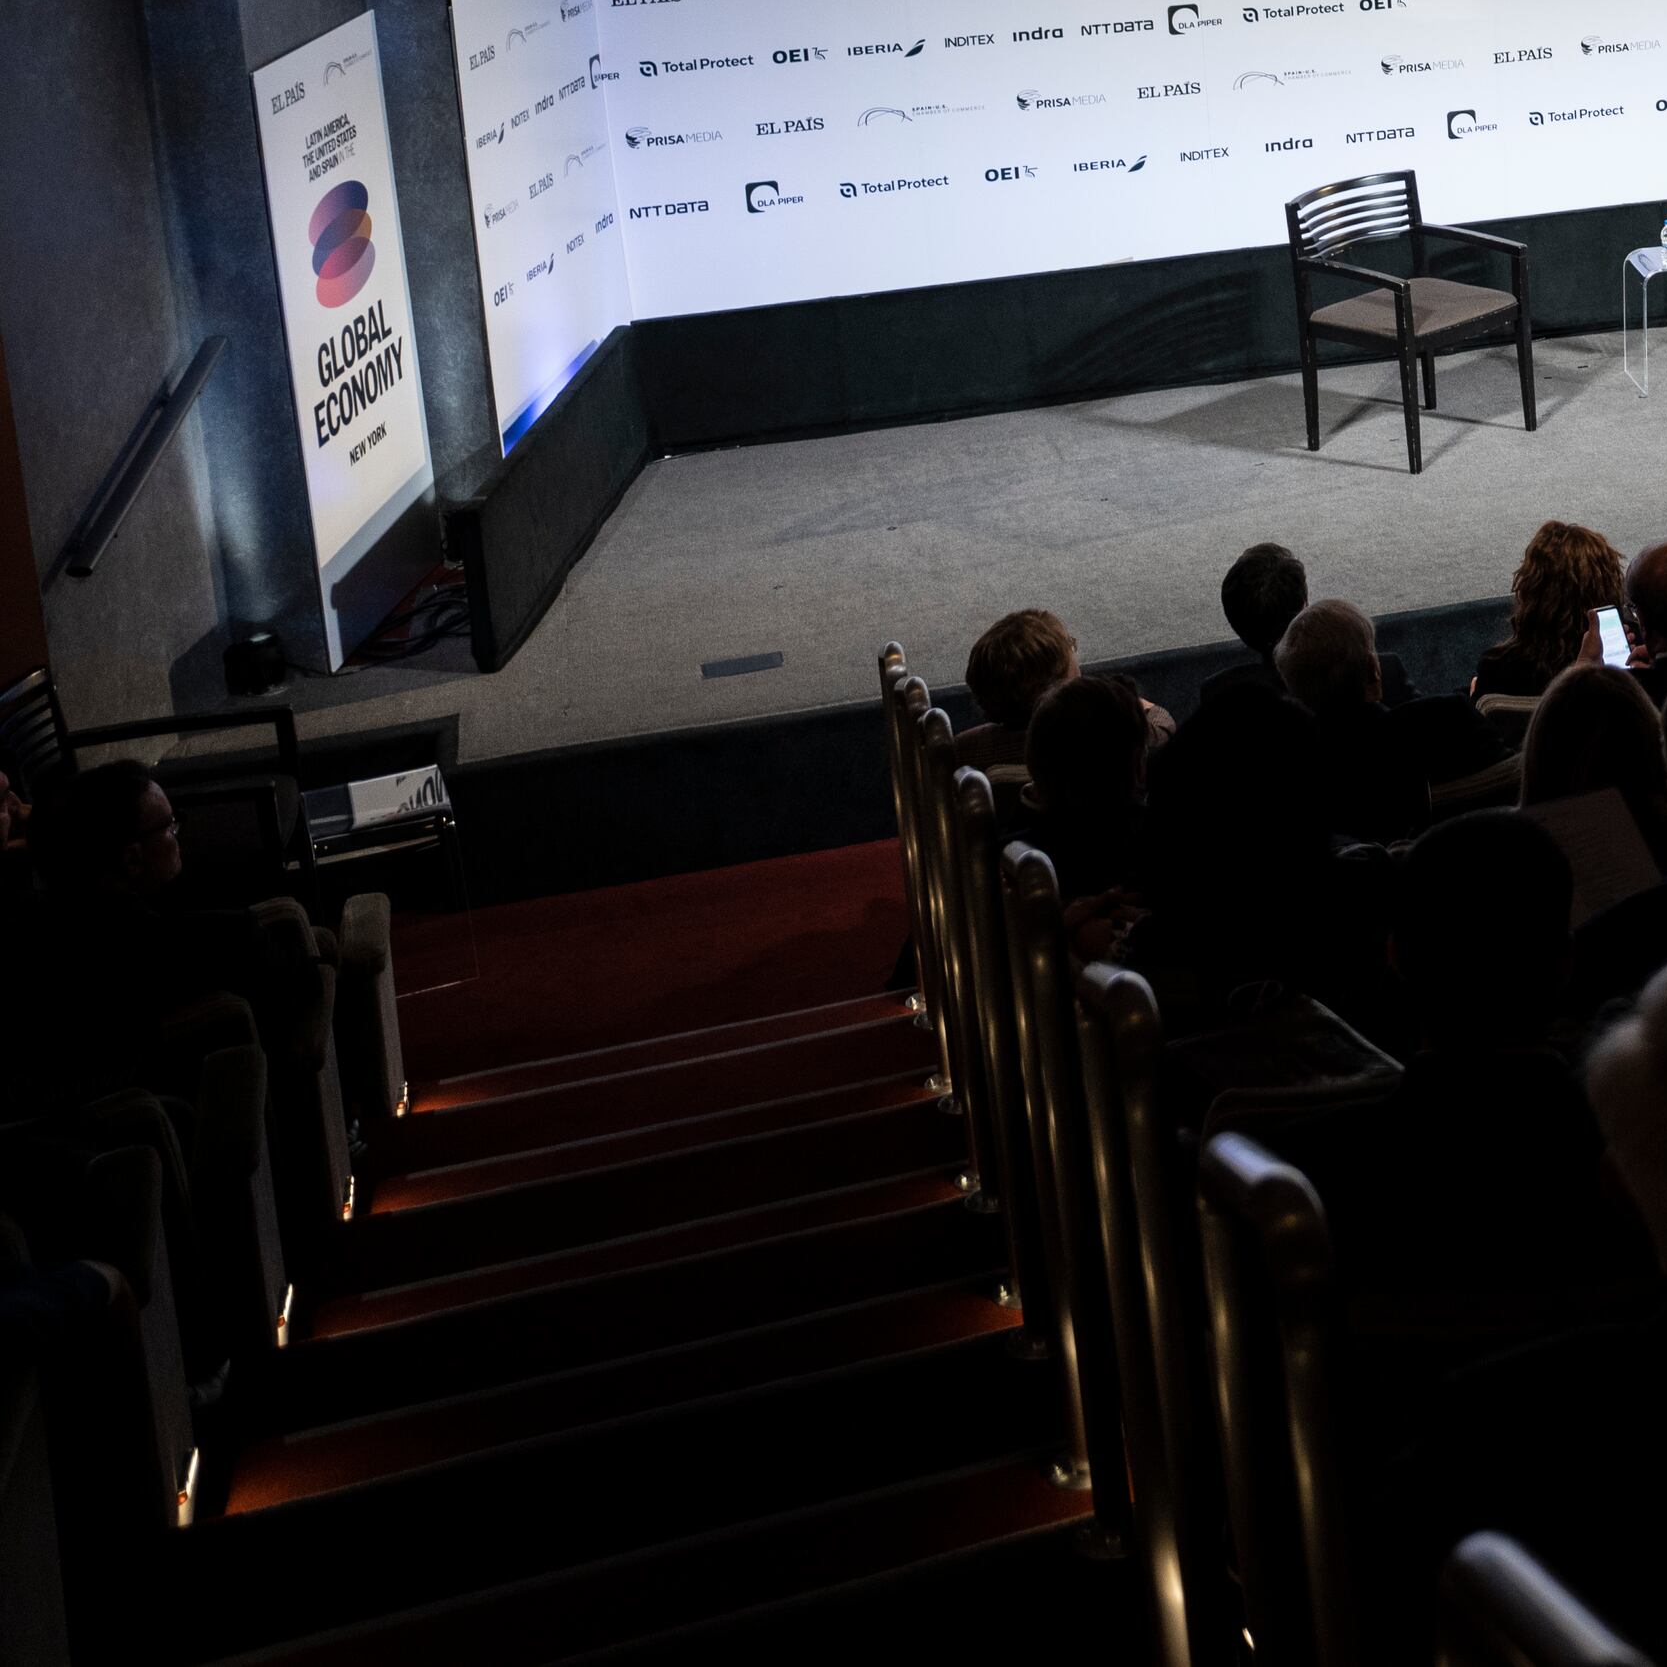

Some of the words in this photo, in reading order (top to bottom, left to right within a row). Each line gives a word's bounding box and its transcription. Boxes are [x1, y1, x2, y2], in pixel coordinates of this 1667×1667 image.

[1263, 6, 1294, 19] Total
[1297, 1, 1344, 16] Protect
[1198, 18, 1222, 27] PIPER
[847, 43, 903, 57] IBERIA
[945, 34, 995, 48] INDITEX
[662, 60, 697, 73] Total
[700, 54, 754, 70] Protect
[772, 48, 809, 64] OEI
[1494, 52, 1516, 64] EL
[1518, 47, 1552, 62] PAÍS
[271, 94, 285, 115] EL
[284, 81, 305, 107] PAÍS
[1137, 87, 1161, 99] EL
[1164, 81, 1201, 96] PAÍS
[1548, 110, 1577, 123] Total
[1580, 105, 1624, 120] Protect
[756, 123, 781, 136] EL
[784, 117, 824, 132] PAÍS
[1457, 125, 1473, 134] DLA
[1475, 123, 1497, 133] PIPER
[302, 150, 315, 168] THE
[315, 138, 336, 160] UNITED
[336, 125, 357, 148] STATES
[306, 129, 323, 150] LATIN
[476, 129, 497, 149] IBERIA
[1346, 131, 1374, 144] NTT
[1180, 147, 1229, 162] INDITEX
[309, 164, 321, 183] AND
[321, 154, 339, 174] SPAIN
[985, 167, 1019, 182] OEI
[1073, 159, 1126, 172] IBERIA
[862, 180, 895, 194] Total
[898, 176, 949, 190] Protect
[757, 199, 775, 207] DLA
[778, 196, 803, 205] PIPER
[629, 205, 662, 219] NTT
[494, 286, 508, 306] OEI
[318, 299, 392, 387] GLOBAL
[314, 337, 402, 448] ECONOMY
[349, 439, 366, 466] NEW
[367, 422, 387, 450] YORK
